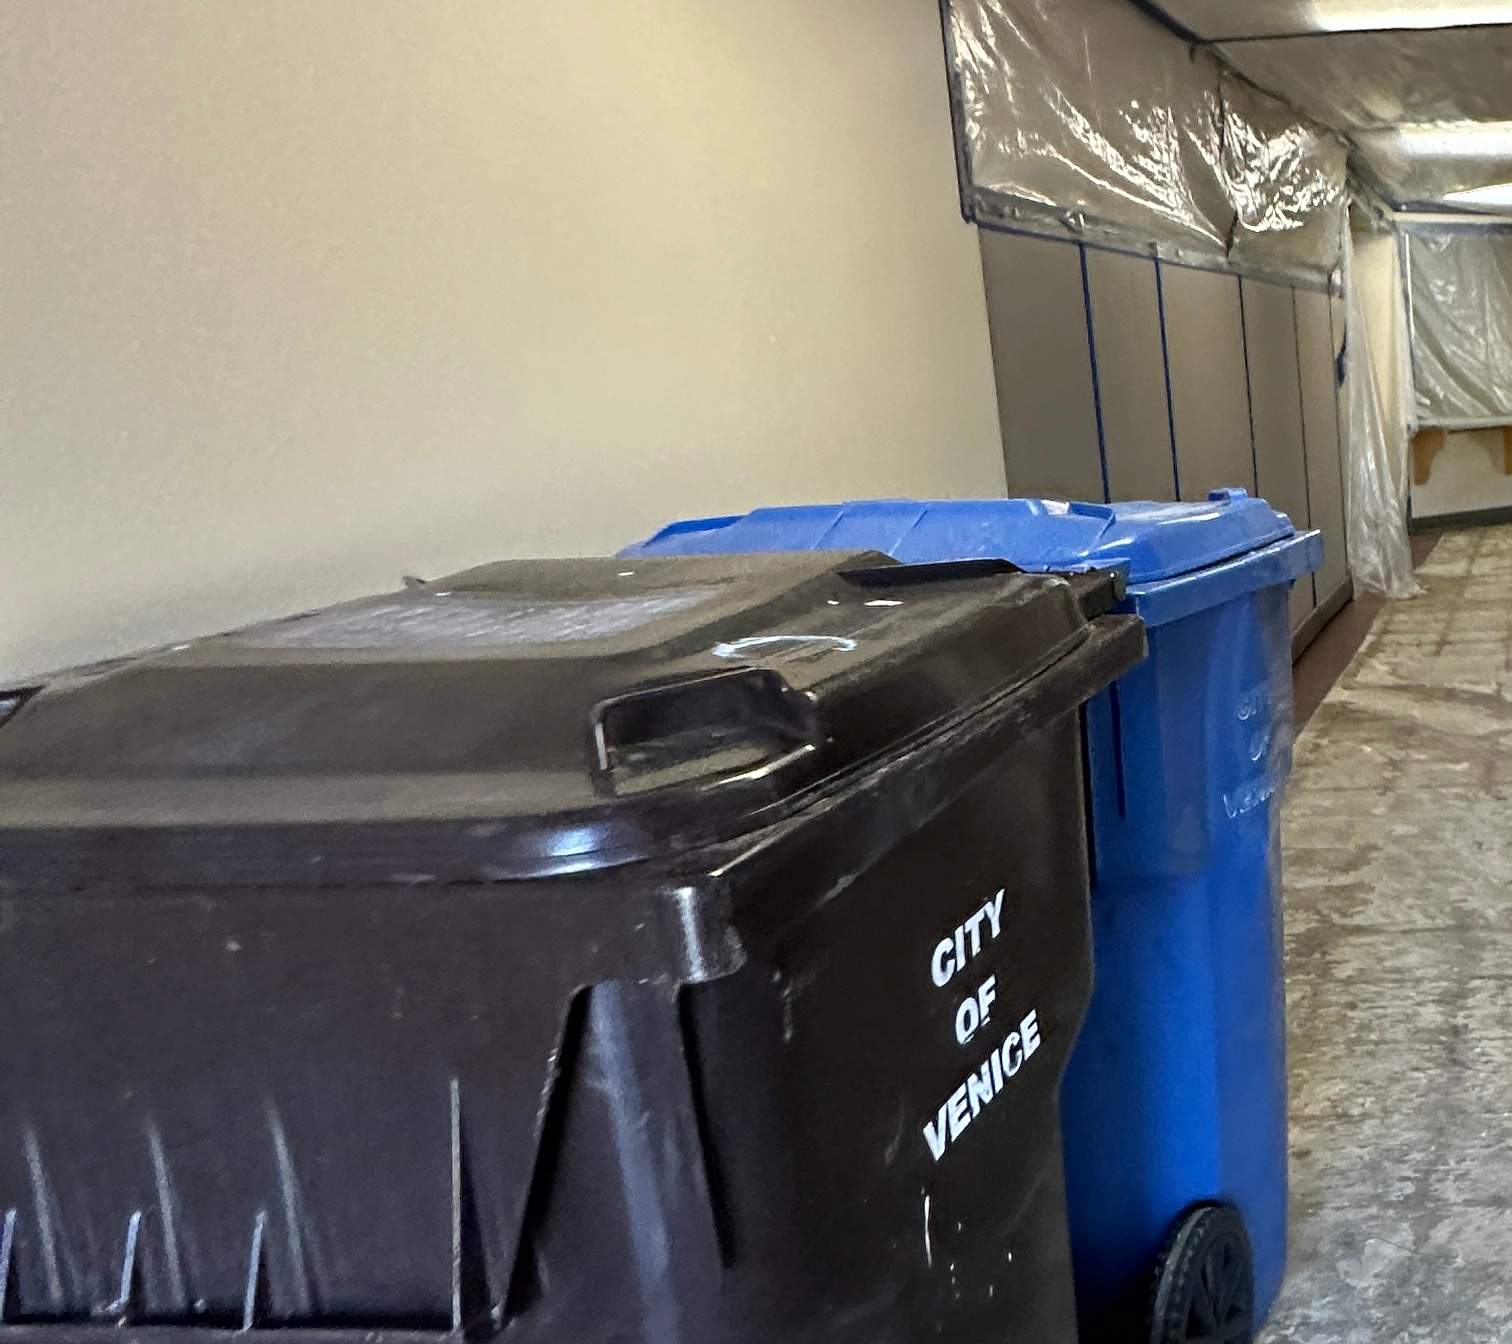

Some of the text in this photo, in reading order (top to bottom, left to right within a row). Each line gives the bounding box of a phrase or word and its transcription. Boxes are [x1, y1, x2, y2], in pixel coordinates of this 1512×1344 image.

[931, 888, 1005, 988] CITY
[954, 974, 997, 1045] OF
[923, 1008, 1042, 1161] VENICE
